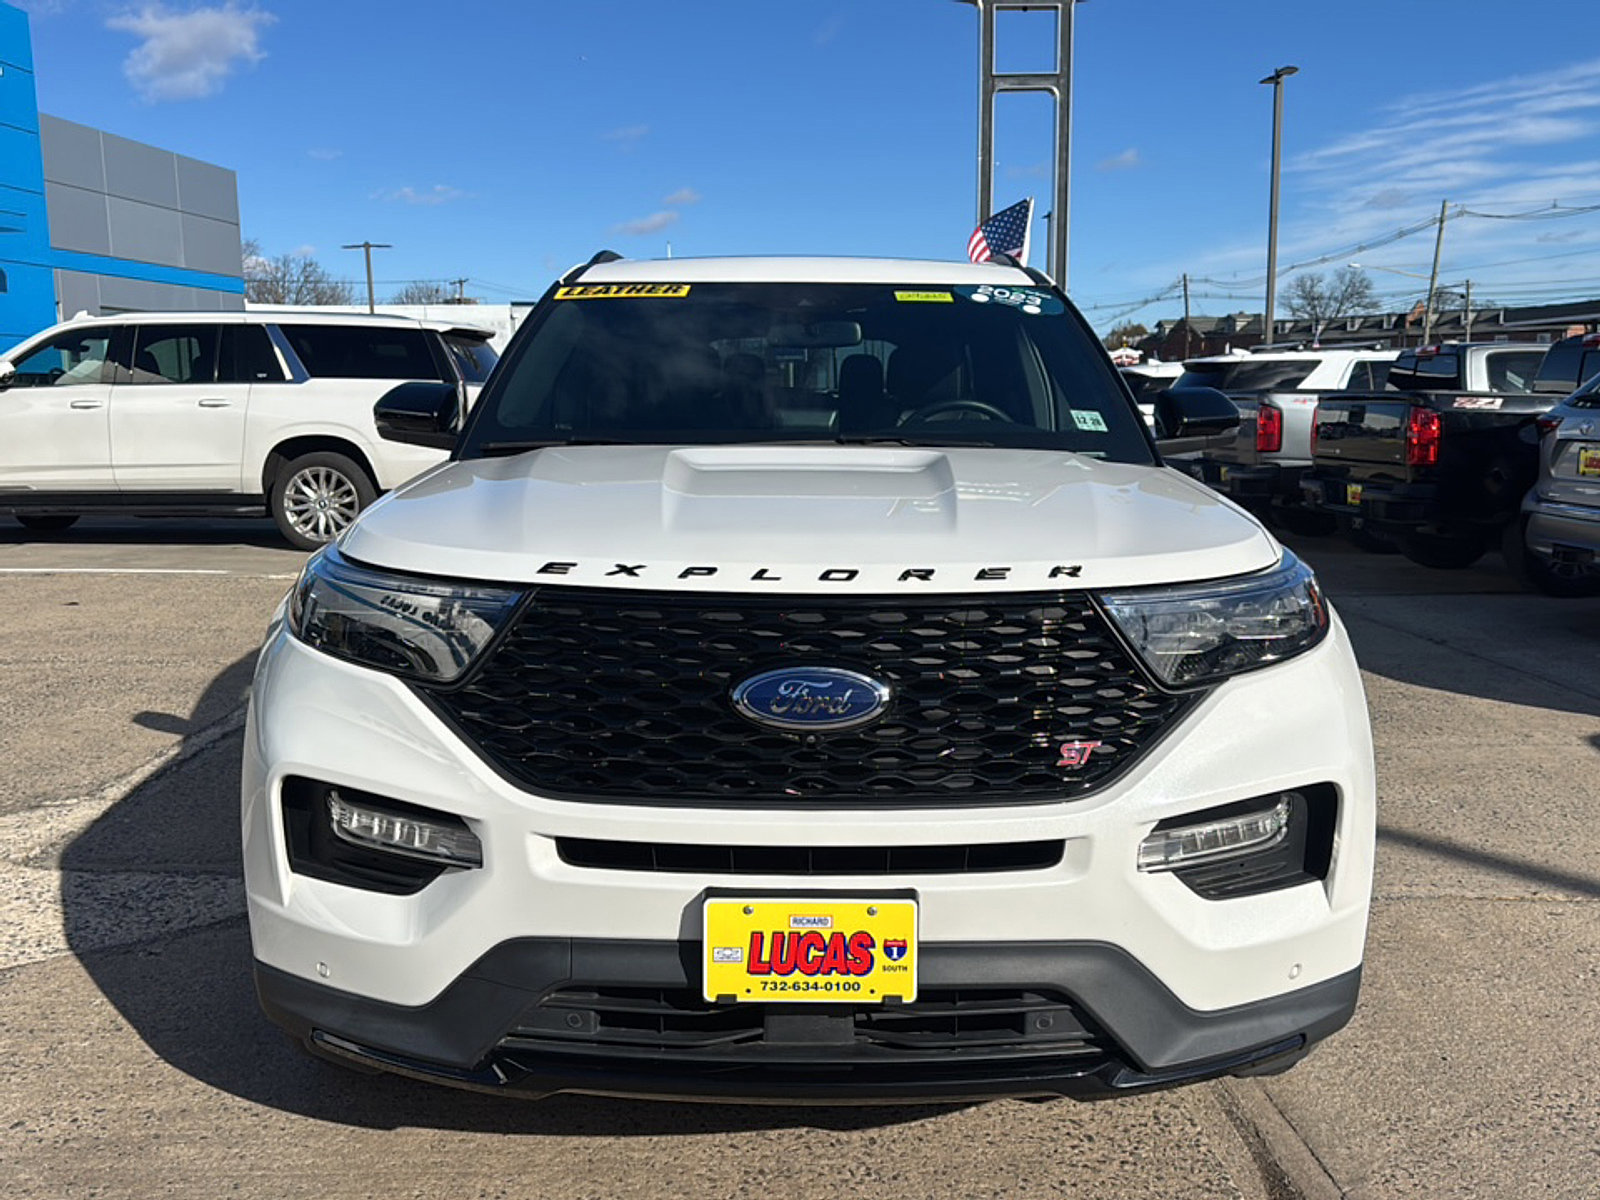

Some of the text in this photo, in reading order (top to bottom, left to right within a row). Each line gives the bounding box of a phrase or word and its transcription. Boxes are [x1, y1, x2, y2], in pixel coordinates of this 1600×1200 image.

[561, 284, 683, 296] LEATHER
[536, 561, 1084, 582] EXPLORER
[769, 679, 854, 714] Ford
[1056, 741, 1102, 767] ST
[791, 916, 830, 926] RICHARD
[747, 931, 876, 976] LUCAS
[890, 946, 900, 960] 1
[881, 965, 908, 973] SOUTH
[760, 980, 862, 992] 732-634-0100
